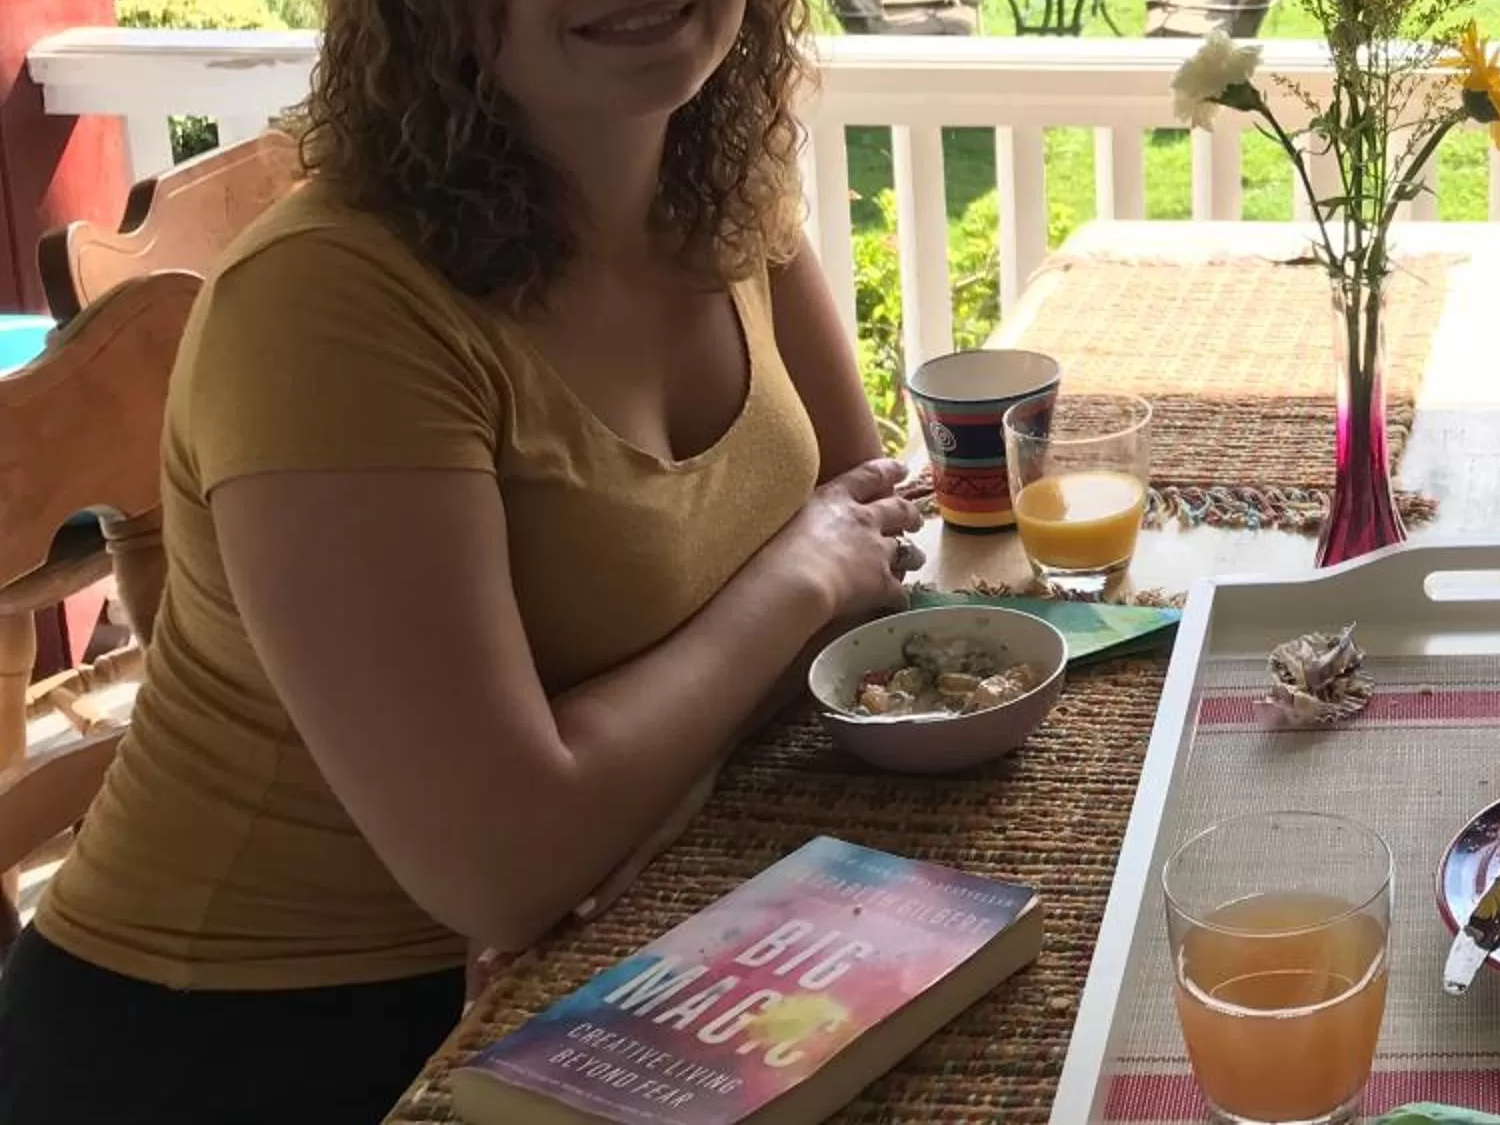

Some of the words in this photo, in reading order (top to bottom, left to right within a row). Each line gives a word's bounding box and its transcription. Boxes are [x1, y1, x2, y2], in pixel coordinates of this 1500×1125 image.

[734, 919, 874, 991] BIG
[549, 1047, 639, 1089] BEYOND
[630, 1079, 695, 1109] FEAR
[566, 1022, 673, 1078] CREATIVE
[668, 1058, 744, 1095] LIVING
